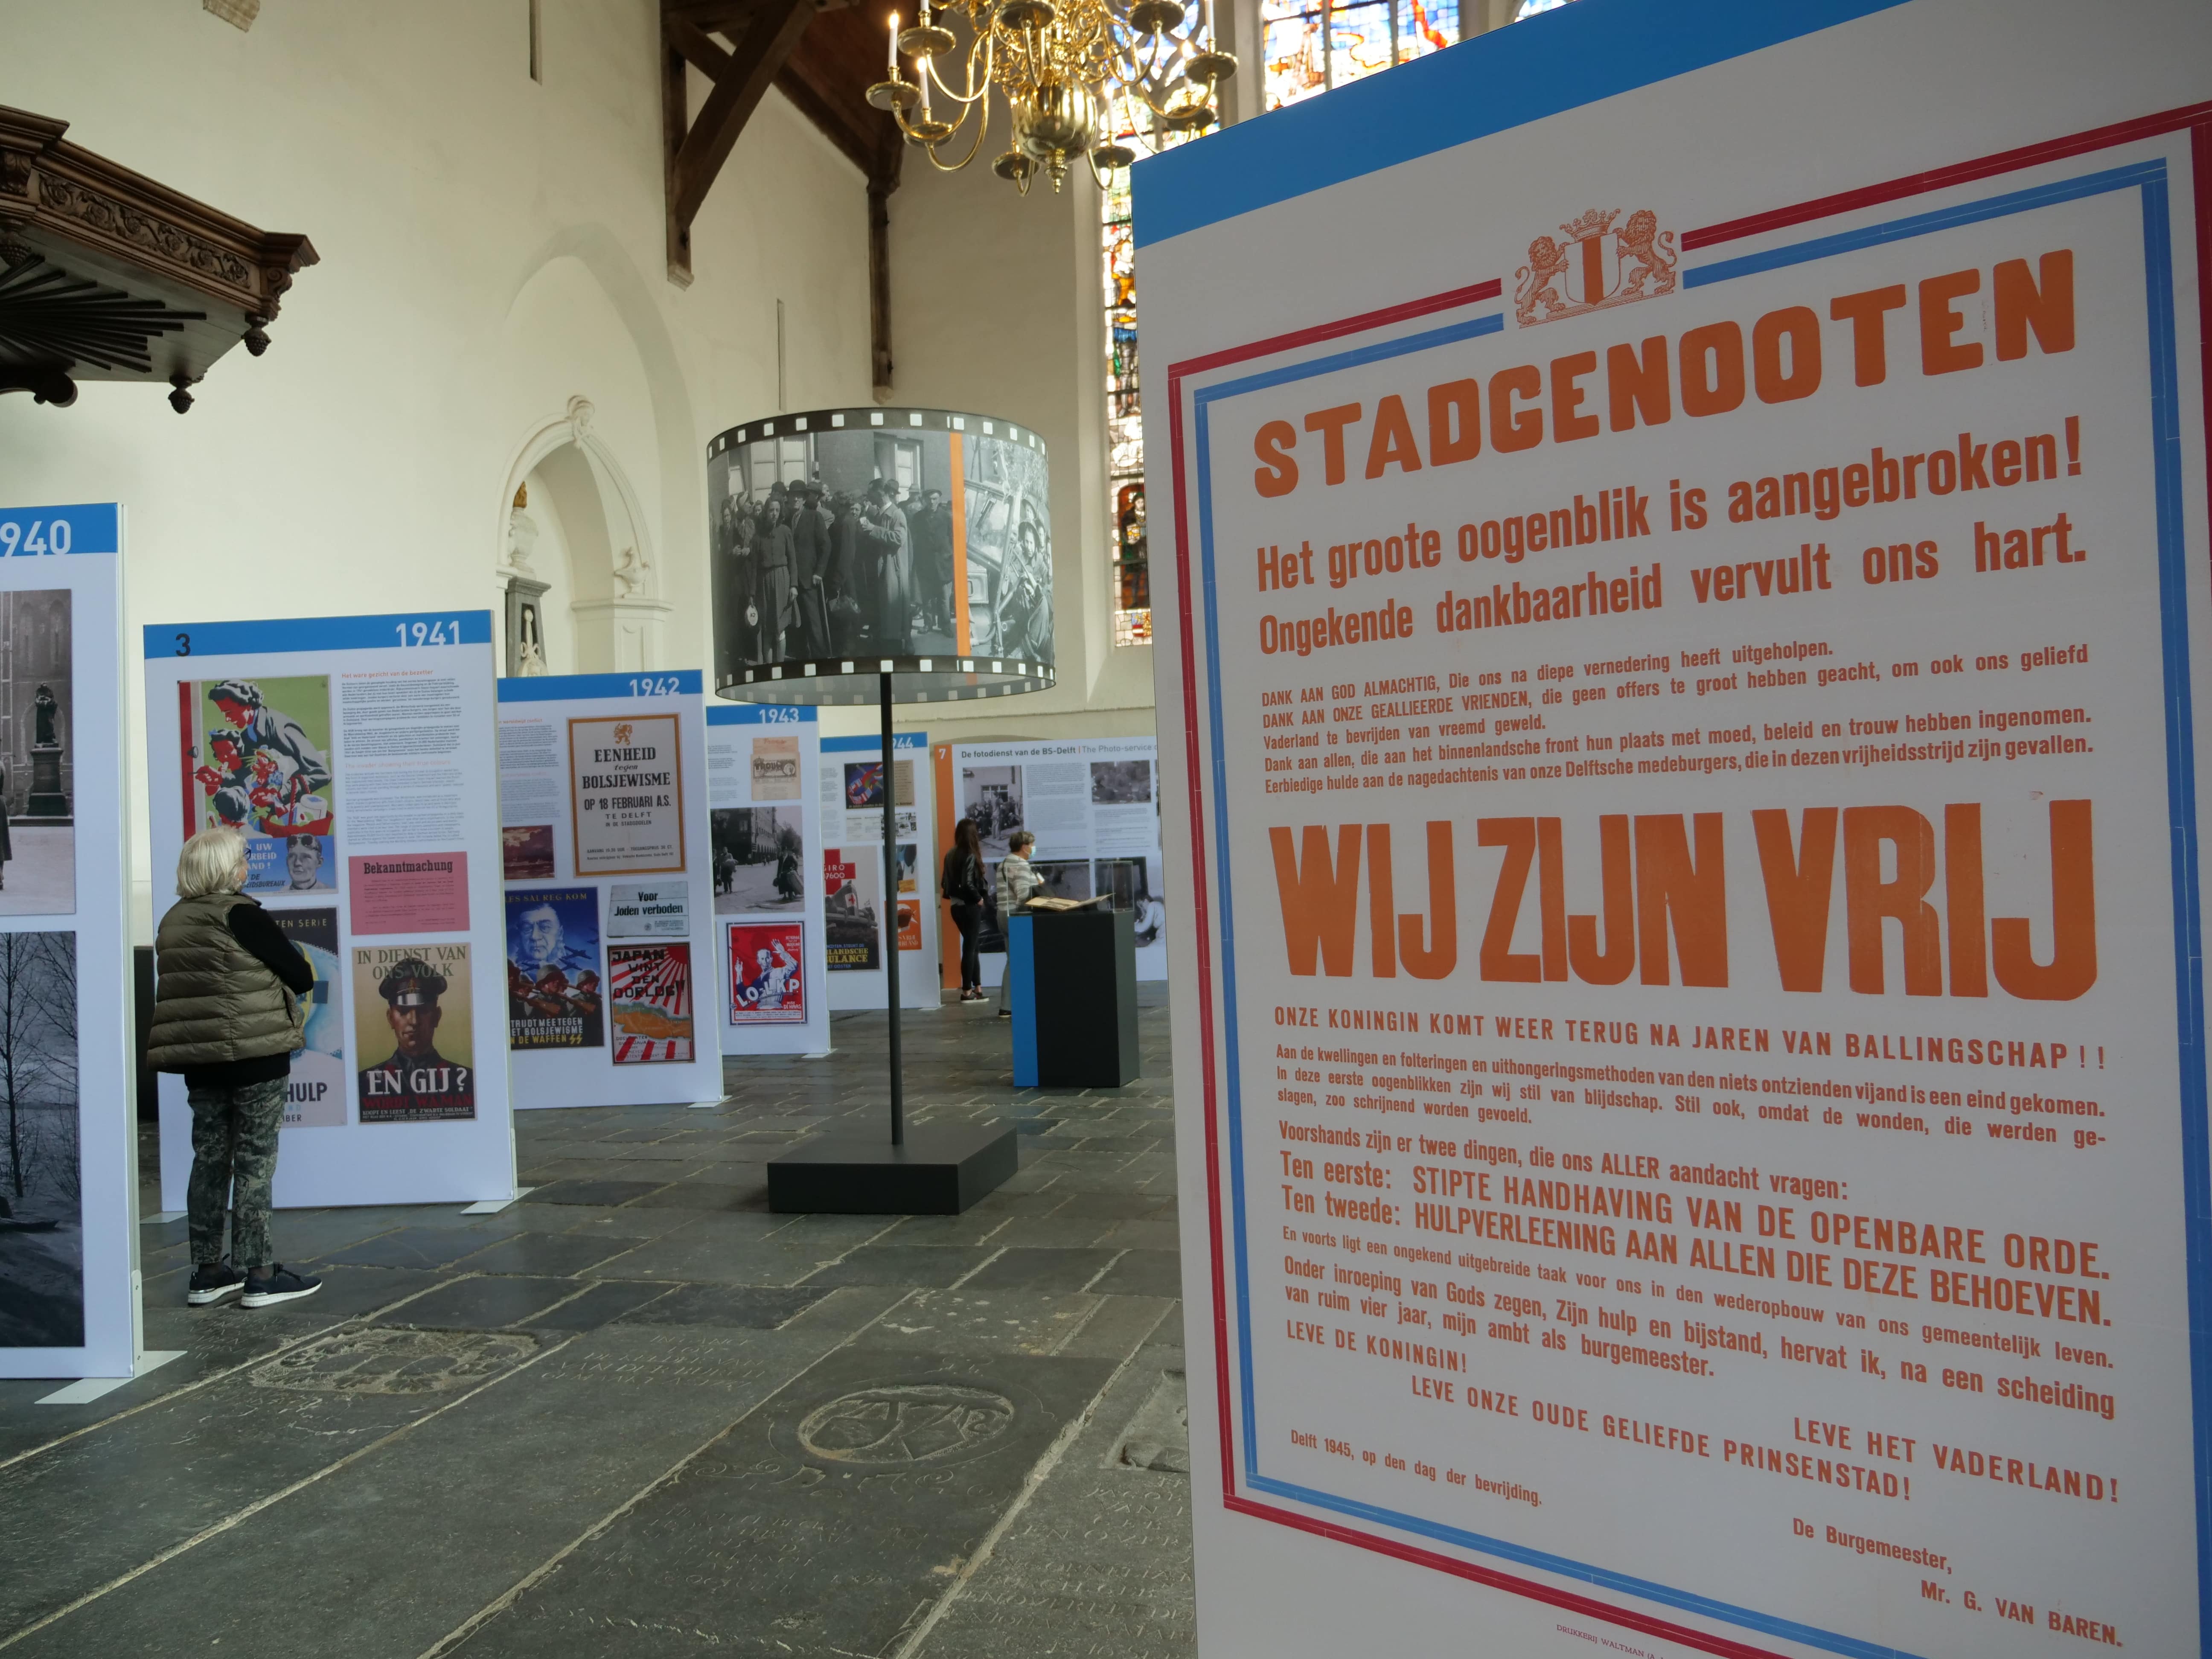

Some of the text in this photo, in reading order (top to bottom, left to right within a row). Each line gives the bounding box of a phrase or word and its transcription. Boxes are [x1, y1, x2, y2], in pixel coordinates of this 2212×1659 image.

[1254, 248, 2075, 498] STADGENOOTEN
[1257, 415, 2081, 592] Het groote oogenblik is aangebroken!
[0, 519, 72, 557] 940
[1259, 512, 2086, 657] Ongekende dankbaarheid vervult ons hart.
[395, 620, 461, 647] 1941
[175, 633, 191, 656] 3
[1262, 640, 1833, 707] DANK AAN GOD ALMACHTIG, Die ons na diepe vernedering heeft uitgeholpen.
[630, 678, 680, 696] 1942
[759, 708, 799, 724] 1943
[893, 737, 914, 749] 944
[974, 748, 1013, 757] fotodienst
[1042, 746, 1076, 755] BS-Delft
[1098, 744, 1151, 753] Photo-service
[594, 747, 656, 763] EENHEID
[939, 749, 946, 759] 7
[582, 772, 671, 789] BOLSJEWISME
[584, 795, 671, 810] OP 18 FEBRUARI A.S.
[364, 860, 453, 874] Bekanntmachung
[638, 891, 658, 902] Voor
[1268, 799, 2097, 1001] WIJ ZIJN VRIJ
[614, 904, 683, 916] Joden verboden
[299, 919, 327, 927] SERIE
[358, 946, 466, 964] IN DIENST VAN
[612, 949, 665, 962] JAPAN
[827, 955, 867, 963] ULANCE
[373, 963, 454, 980] ONS VOLK
[629, 963, 661, 972] WINT
[511, 1019, 537, 1027] TRIJDT
[525, 1026, 583, 1036] BOLSJEWISME
[519, 1036, 529, 1044] DE
[533, 1034, 567, 1043] WAFFEN
[367, 1069, 402, 1094] EN
[410, 1068, 450, 1093] GIJ
[1279, 1150, 1390, 1189] Ten eerste:
[1281, 1184, 1400, 1225] Ten tweede:
[1413, 1165, 2109, 1280] STIPTE HANDHAVING VAN DE OPENBARE ORDE.
[1415, 1201, 2111, 1326] HULPVERLEENING AAN ALLEN DIE DEZE BEHOEVEN.
[1412, 1375, 1909, 1500] LEVE ONZE OUDE GELIEFDE PRINSENSTAD!
[1291, 1429, 1542, 1507] Delft 1945, op den dag der bevrijding.
[1793, 1517, 1952, 1575] De Burgemeester,
[1921, 1580, 2122, 1647] Mr. G. VAN BAREN.
[1557, 1624, 1597, 1644] DRUKKERIJ
[1601, 1638, 1644, 1657] WALTMAN
